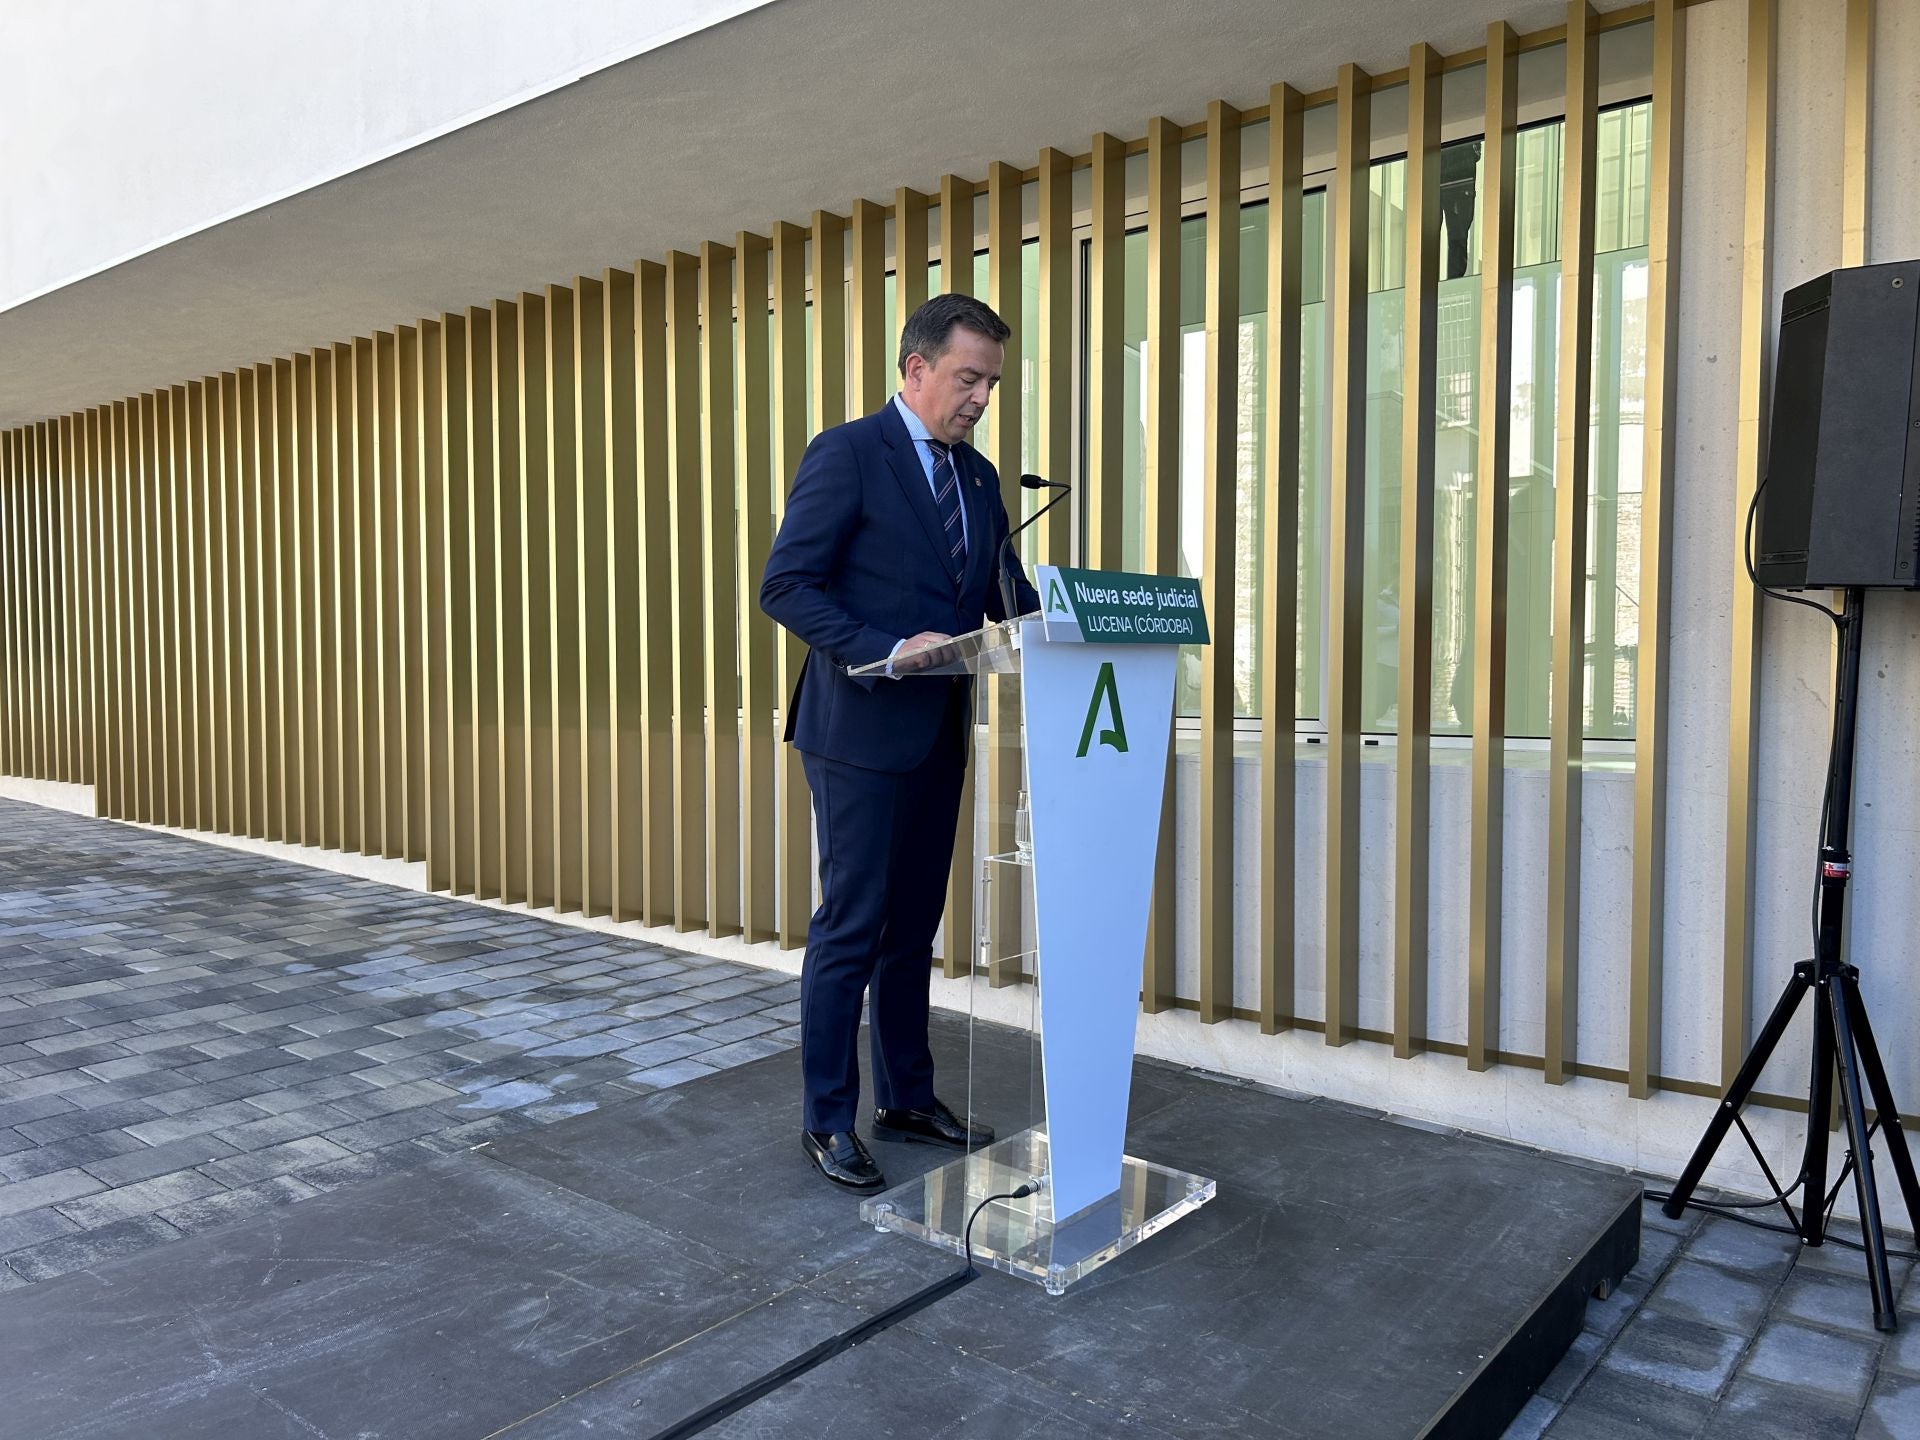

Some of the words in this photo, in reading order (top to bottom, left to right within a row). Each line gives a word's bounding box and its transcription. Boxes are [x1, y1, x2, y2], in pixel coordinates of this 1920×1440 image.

[1047, 578, 1068, 613] A
[1074, 581, 1119, 604] Nueva
[1122, 585, 1154, 606] sede
[1155, 587, 1198, 611] judicial
[1087, 615, 1133, 632] LUCENA
[1134, 613, 1193, 634] (CÓRDOBA)
[1075, 662, 1129, 758] A
